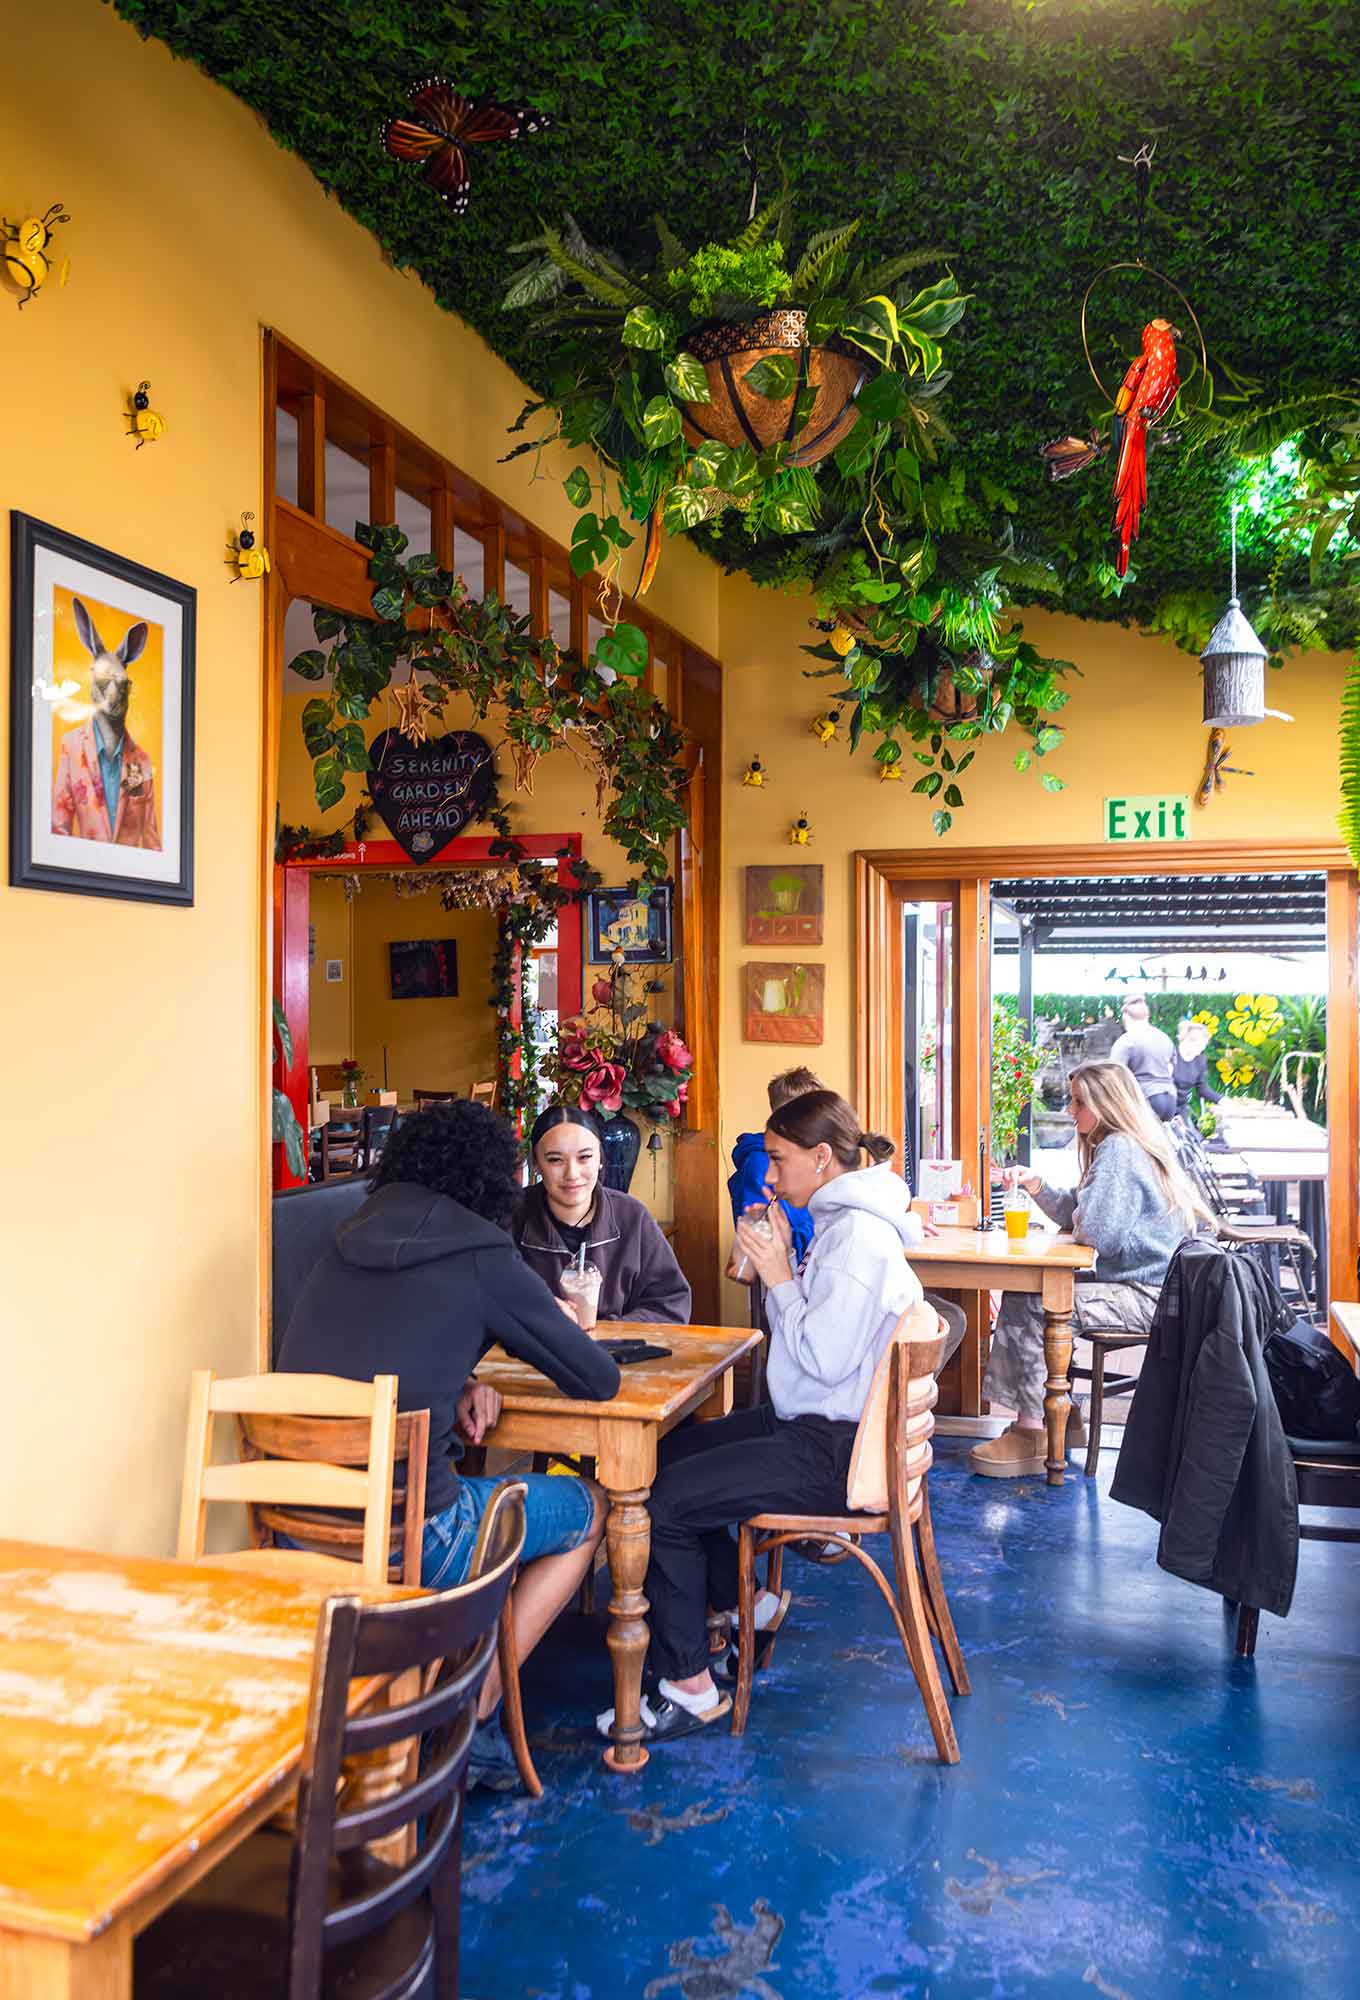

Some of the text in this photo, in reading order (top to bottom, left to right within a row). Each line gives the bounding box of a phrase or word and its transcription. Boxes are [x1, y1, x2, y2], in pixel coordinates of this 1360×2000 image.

[392, 753, 481, 774] SERENITY
[392, 779, 469, 800] GARDEN
[399, 808, 460, 829] AHEAD
[1109, 800, 1185, 838] Exit
